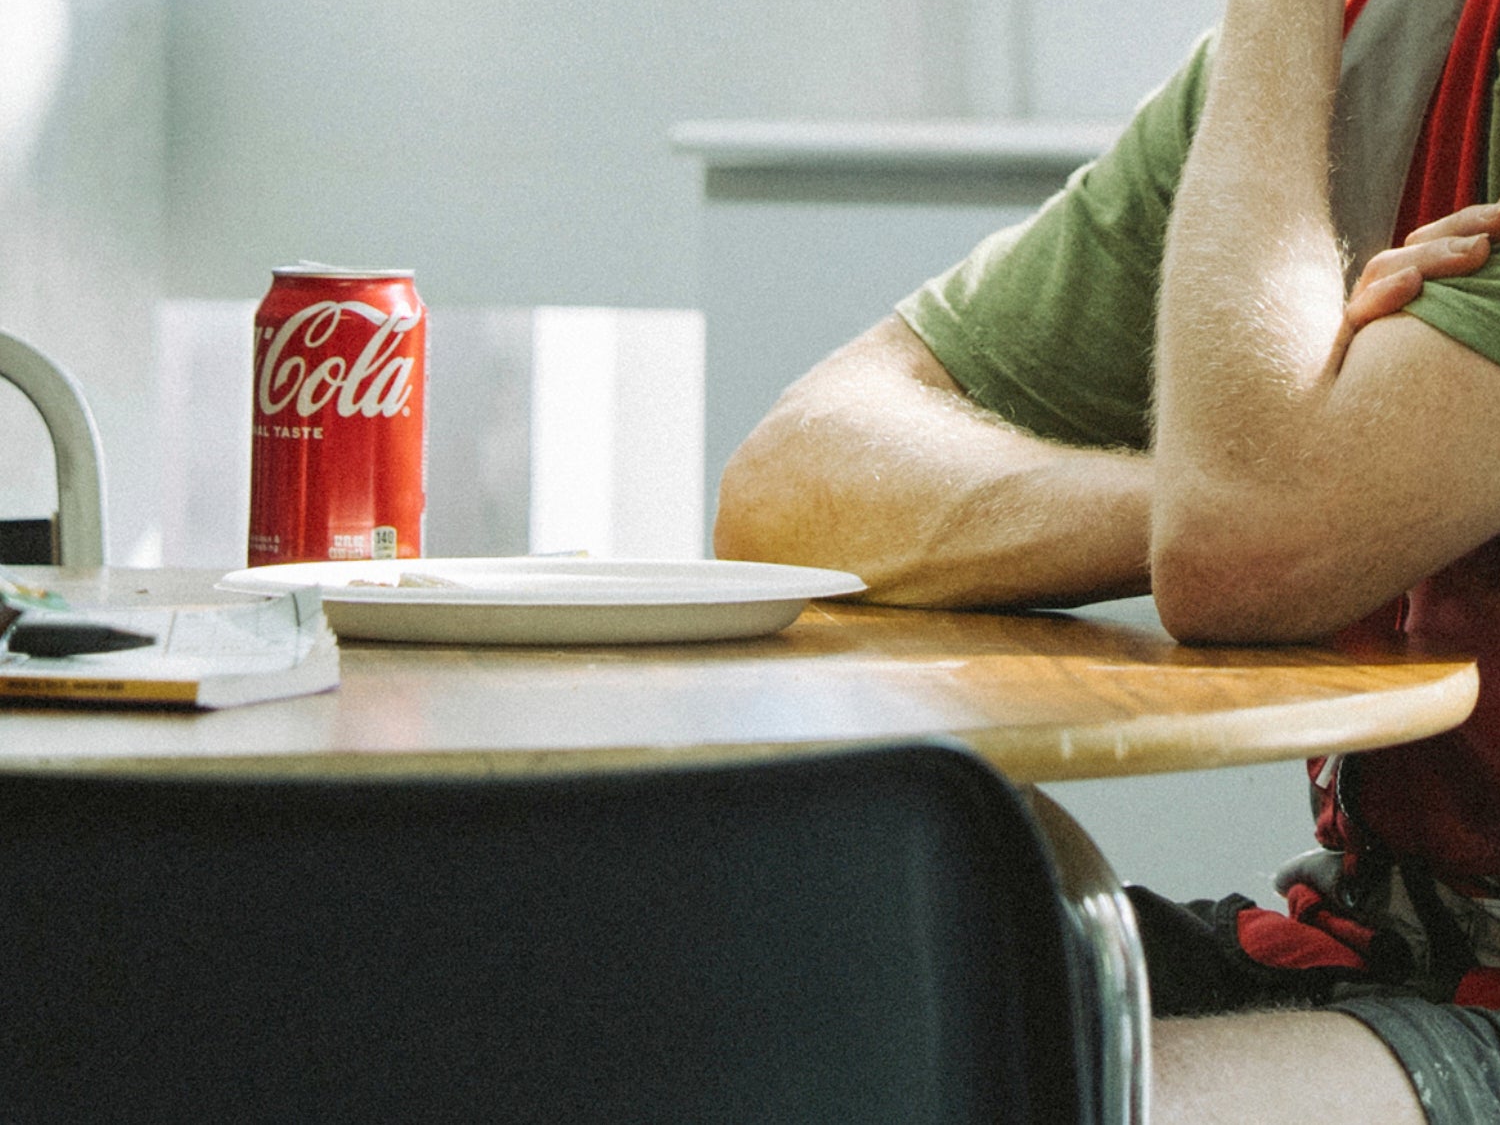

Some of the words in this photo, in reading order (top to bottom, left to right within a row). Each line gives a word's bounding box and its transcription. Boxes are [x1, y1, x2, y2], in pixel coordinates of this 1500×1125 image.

[259, 300, 421, 418] Cola
[253, 425, 270, 438] AL
[272, 425, 324, 440] TASTE
[375, 530, 393, 545] 140
